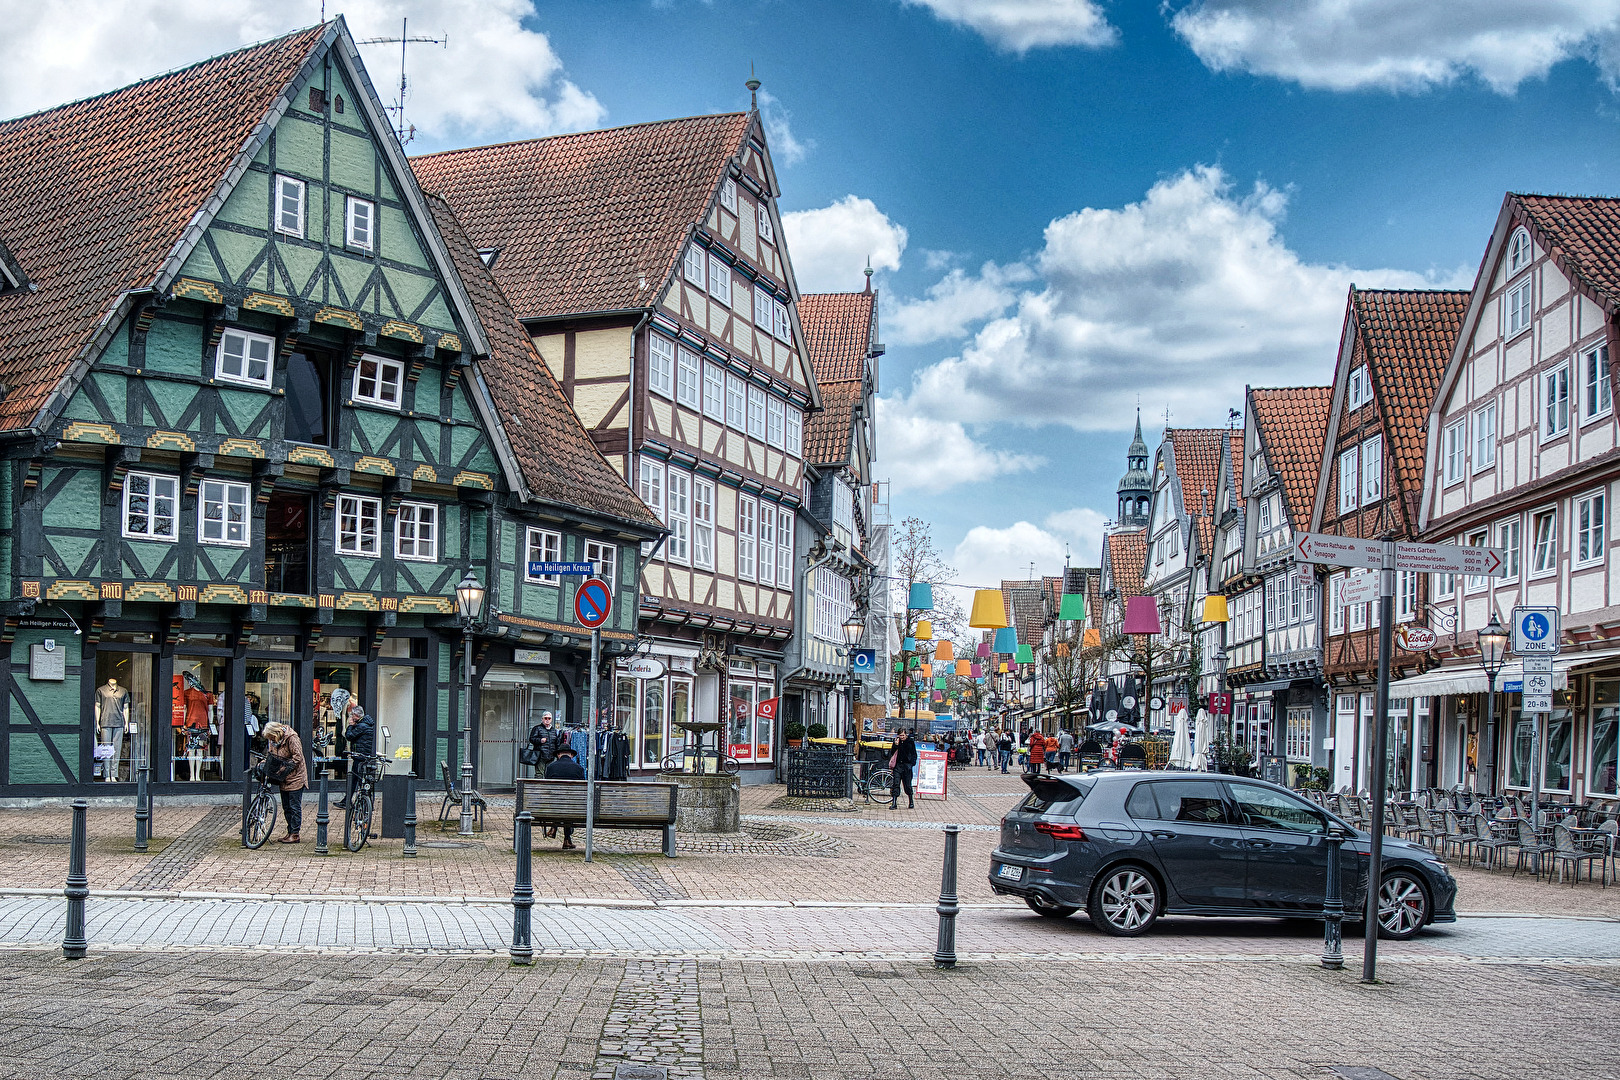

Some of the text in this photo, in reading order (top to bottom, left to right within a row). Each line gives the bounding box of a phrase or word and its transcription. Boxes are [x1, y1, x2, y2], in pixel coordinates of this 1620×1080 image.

[532, 563, 542, 571] Am
[544, 563, 570, 573] Heiligen
[856, 654, 871, 669] O2
